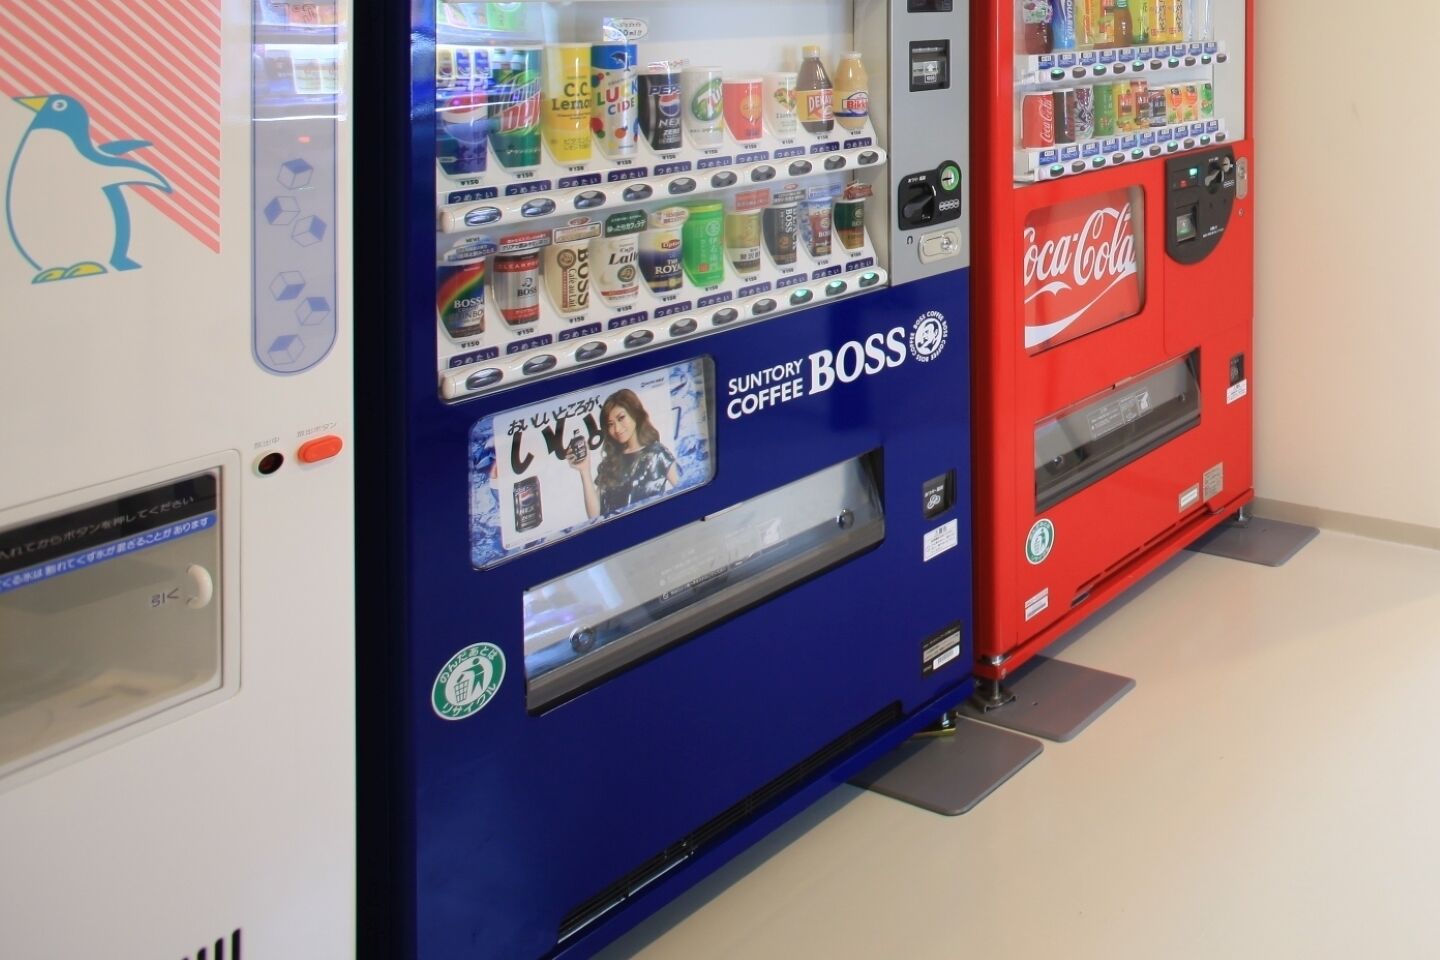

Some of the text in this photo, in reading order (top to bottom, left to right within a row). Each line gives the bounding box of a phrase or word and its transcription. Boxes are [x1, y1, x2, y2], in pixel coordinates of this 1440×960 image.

[552, 98, 591, 111] Lemo
[612, 170, 645, 182] つめたい
[657, 164, 689, 175] つめたい
[510, 182, 548, 195] つめたい
[562, 176, 598, 188] つめたい
[453, 190, 493, 204] つめたい
[577, 248, 589, 307] BOSS
[657, 305, 690, 317] つめたい
[612, 314, 645, 327] つめたい
[563, 326, 599, 338] つめたい
[511, 337, 549, 352] つめたい
[454, 351, 495, 366] つめたい
[808, 326, 907, 395] BOSS
[728, 358, 804, 396] SUNTORY
[727, 377, 804, 420] COFFEE
[151, 587, 180, 608] 引く
[441, 683, 497, 717] リサイクル
